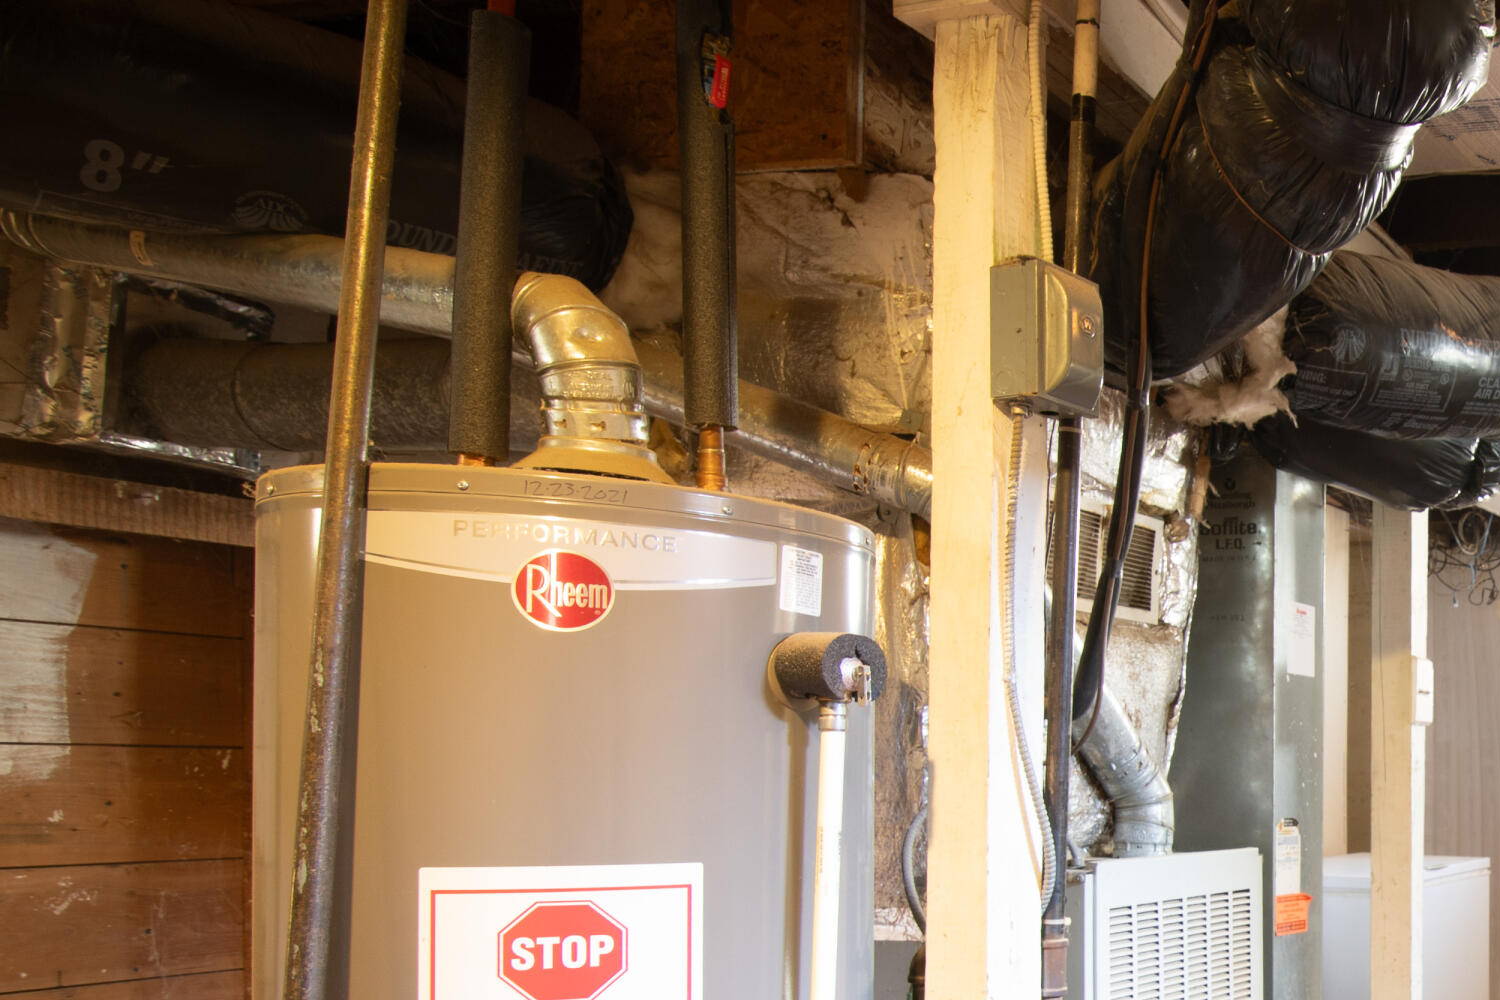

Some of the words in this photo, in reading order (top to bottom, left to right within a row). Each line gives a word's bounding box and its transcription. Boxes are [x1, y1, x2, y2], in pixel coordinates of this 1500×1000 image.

[1474, 388, 1494, 399] AIR
[453, 519, 678, 553] PERFORMANCE
[526, 550, 608, 617] Rheem
[510, 934, 615, 971] STOP
